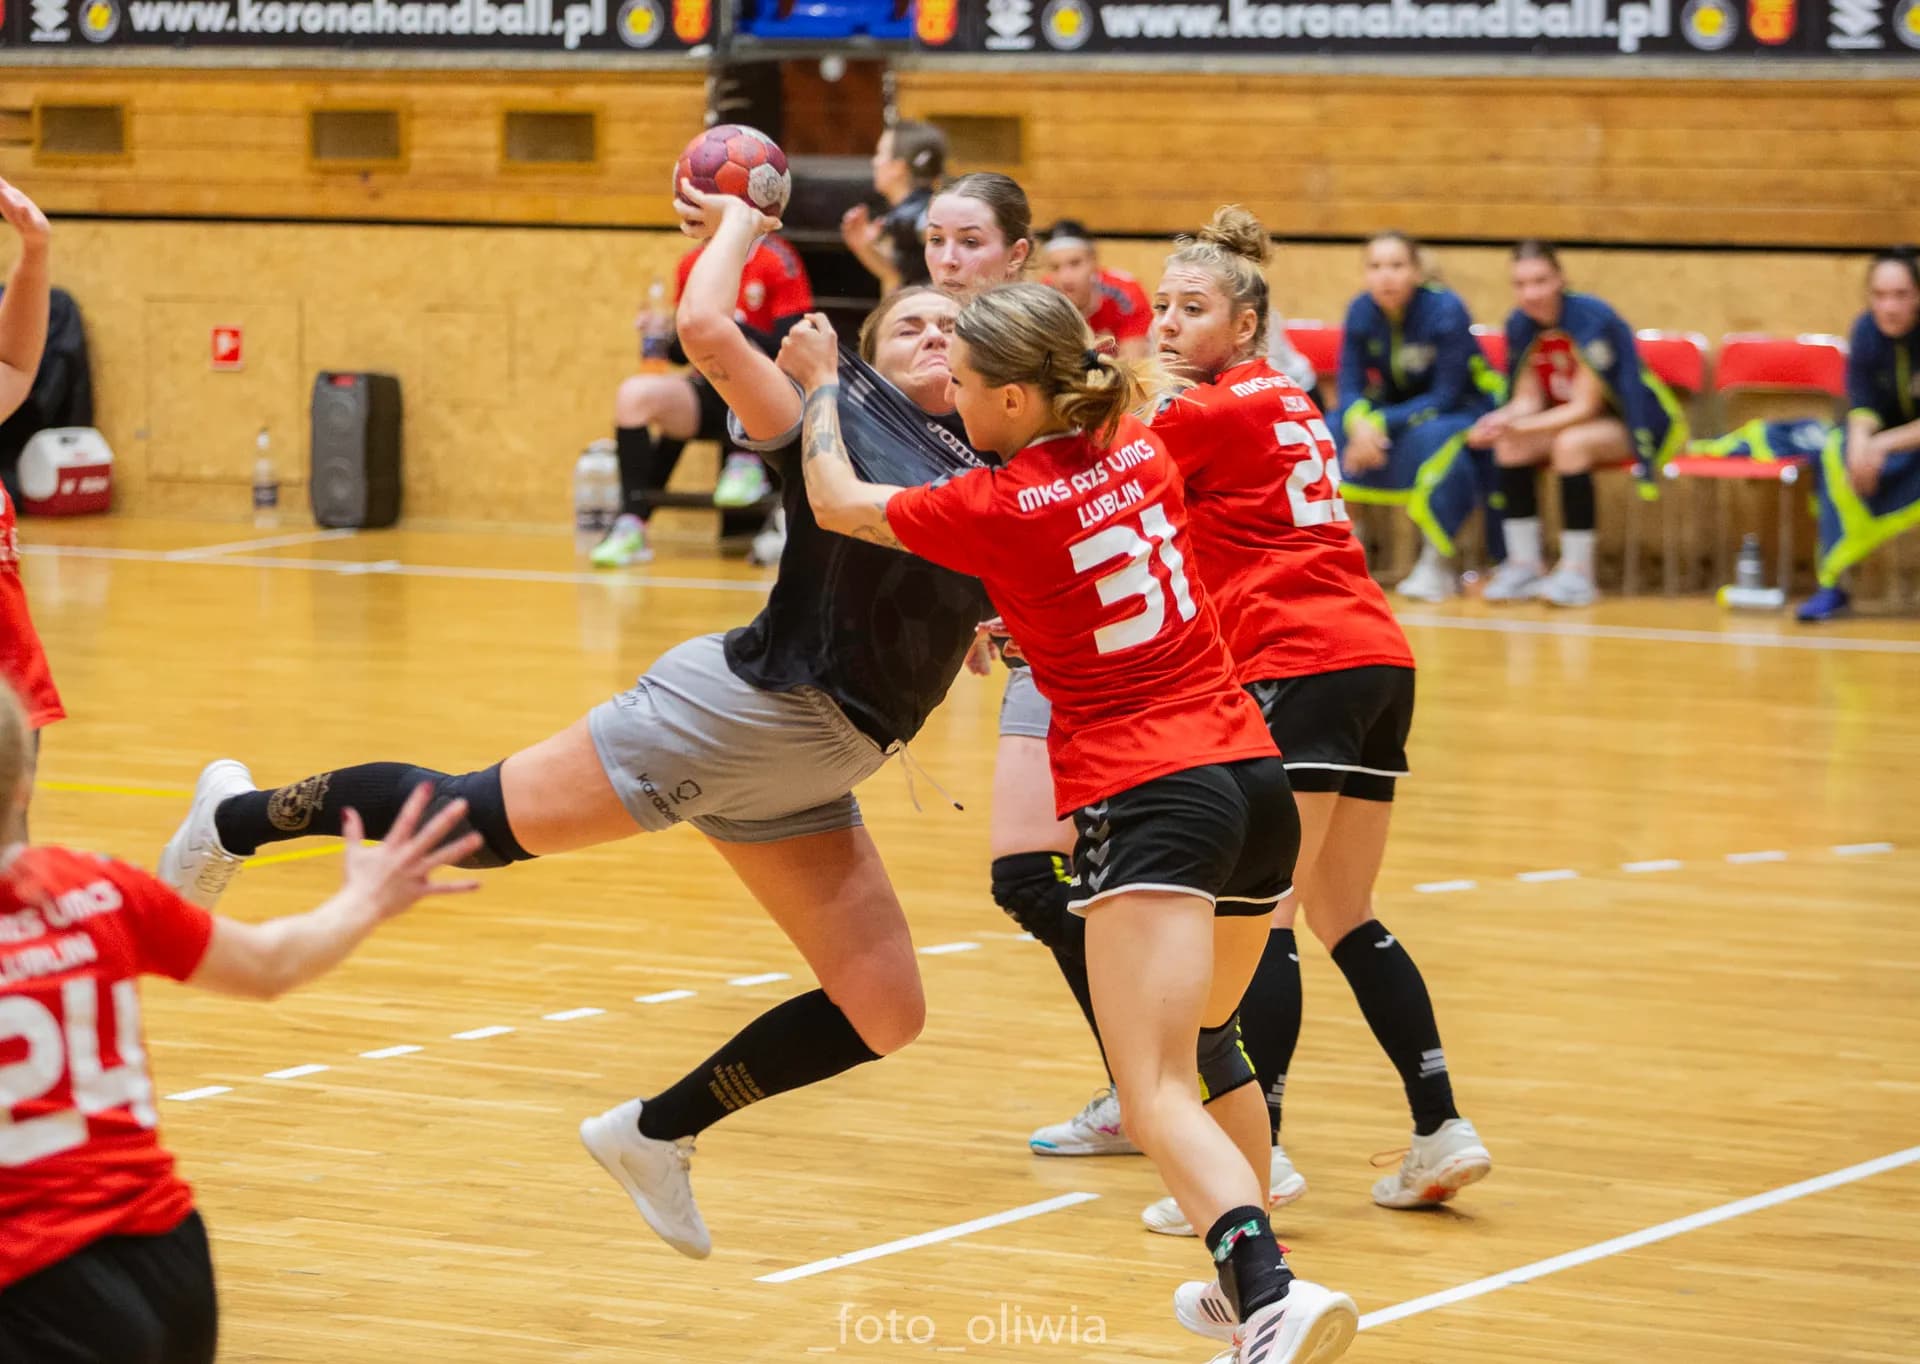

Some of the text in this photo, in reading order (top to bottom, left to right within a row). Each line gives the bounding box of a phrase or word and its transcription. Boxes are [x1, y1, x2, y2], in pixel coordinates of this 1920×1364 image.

[129, 0, 606, 49] www.koronahandball.pl
[1100, 0, 1669, 53] www.koronahandball.pl
[1017, 478, 1072, 512] MKS
[1106, 438, 1156, 473] UMCS
[1076, 479, 1145, 529] LUBLIN
[1069, 502, 1197, 655] 31
[0, 976, 157, 1166] 24
